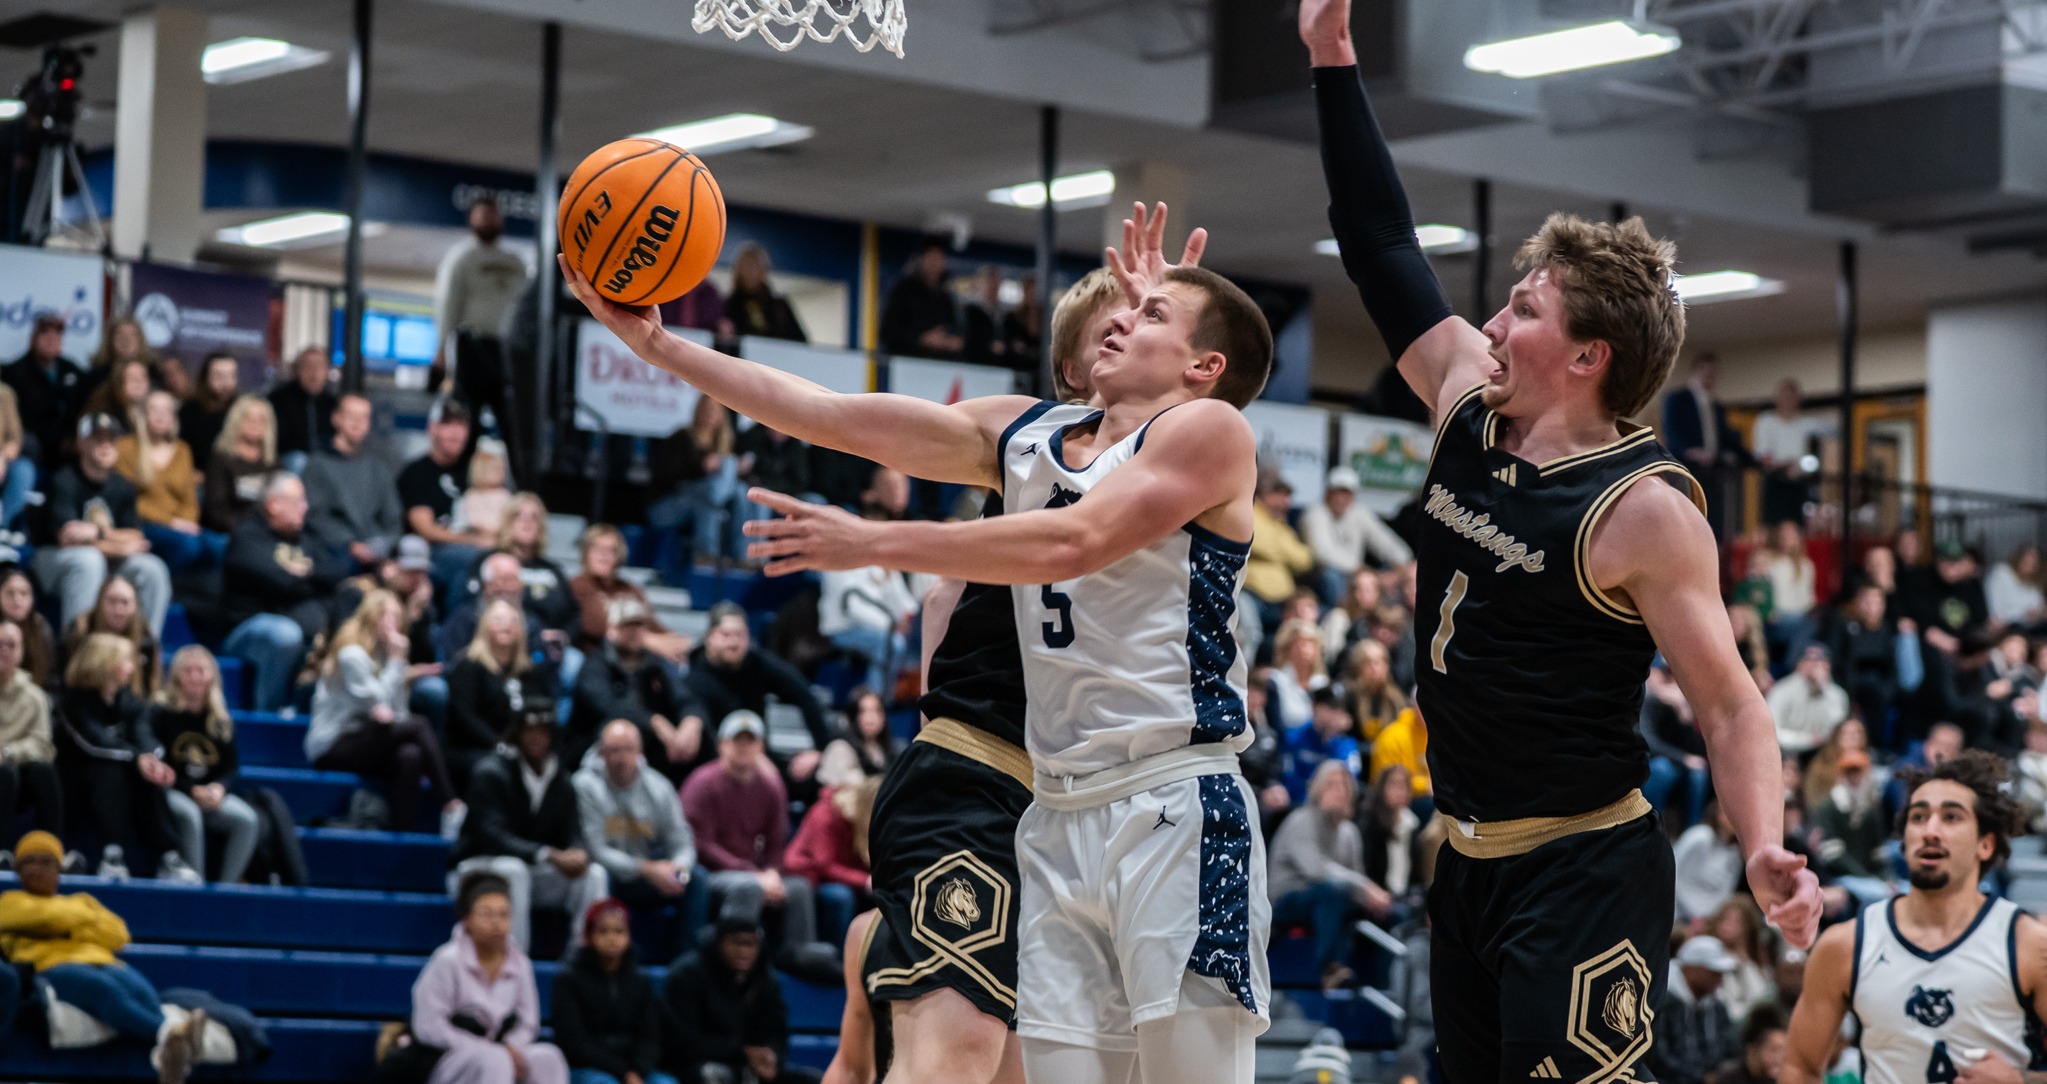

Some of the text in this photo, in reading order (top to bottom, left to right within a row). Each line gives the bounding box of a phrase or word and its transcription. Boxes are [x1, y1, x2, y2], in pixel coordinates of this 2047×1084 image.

[573, 189, 613, 254] EVO
[603, 204, 681, 294] Wilson
[1424, 483, 1546, 573] Mustangs
[1041, 583, 1076, 649] 5
[1430, 568, 1470, 675] 1
